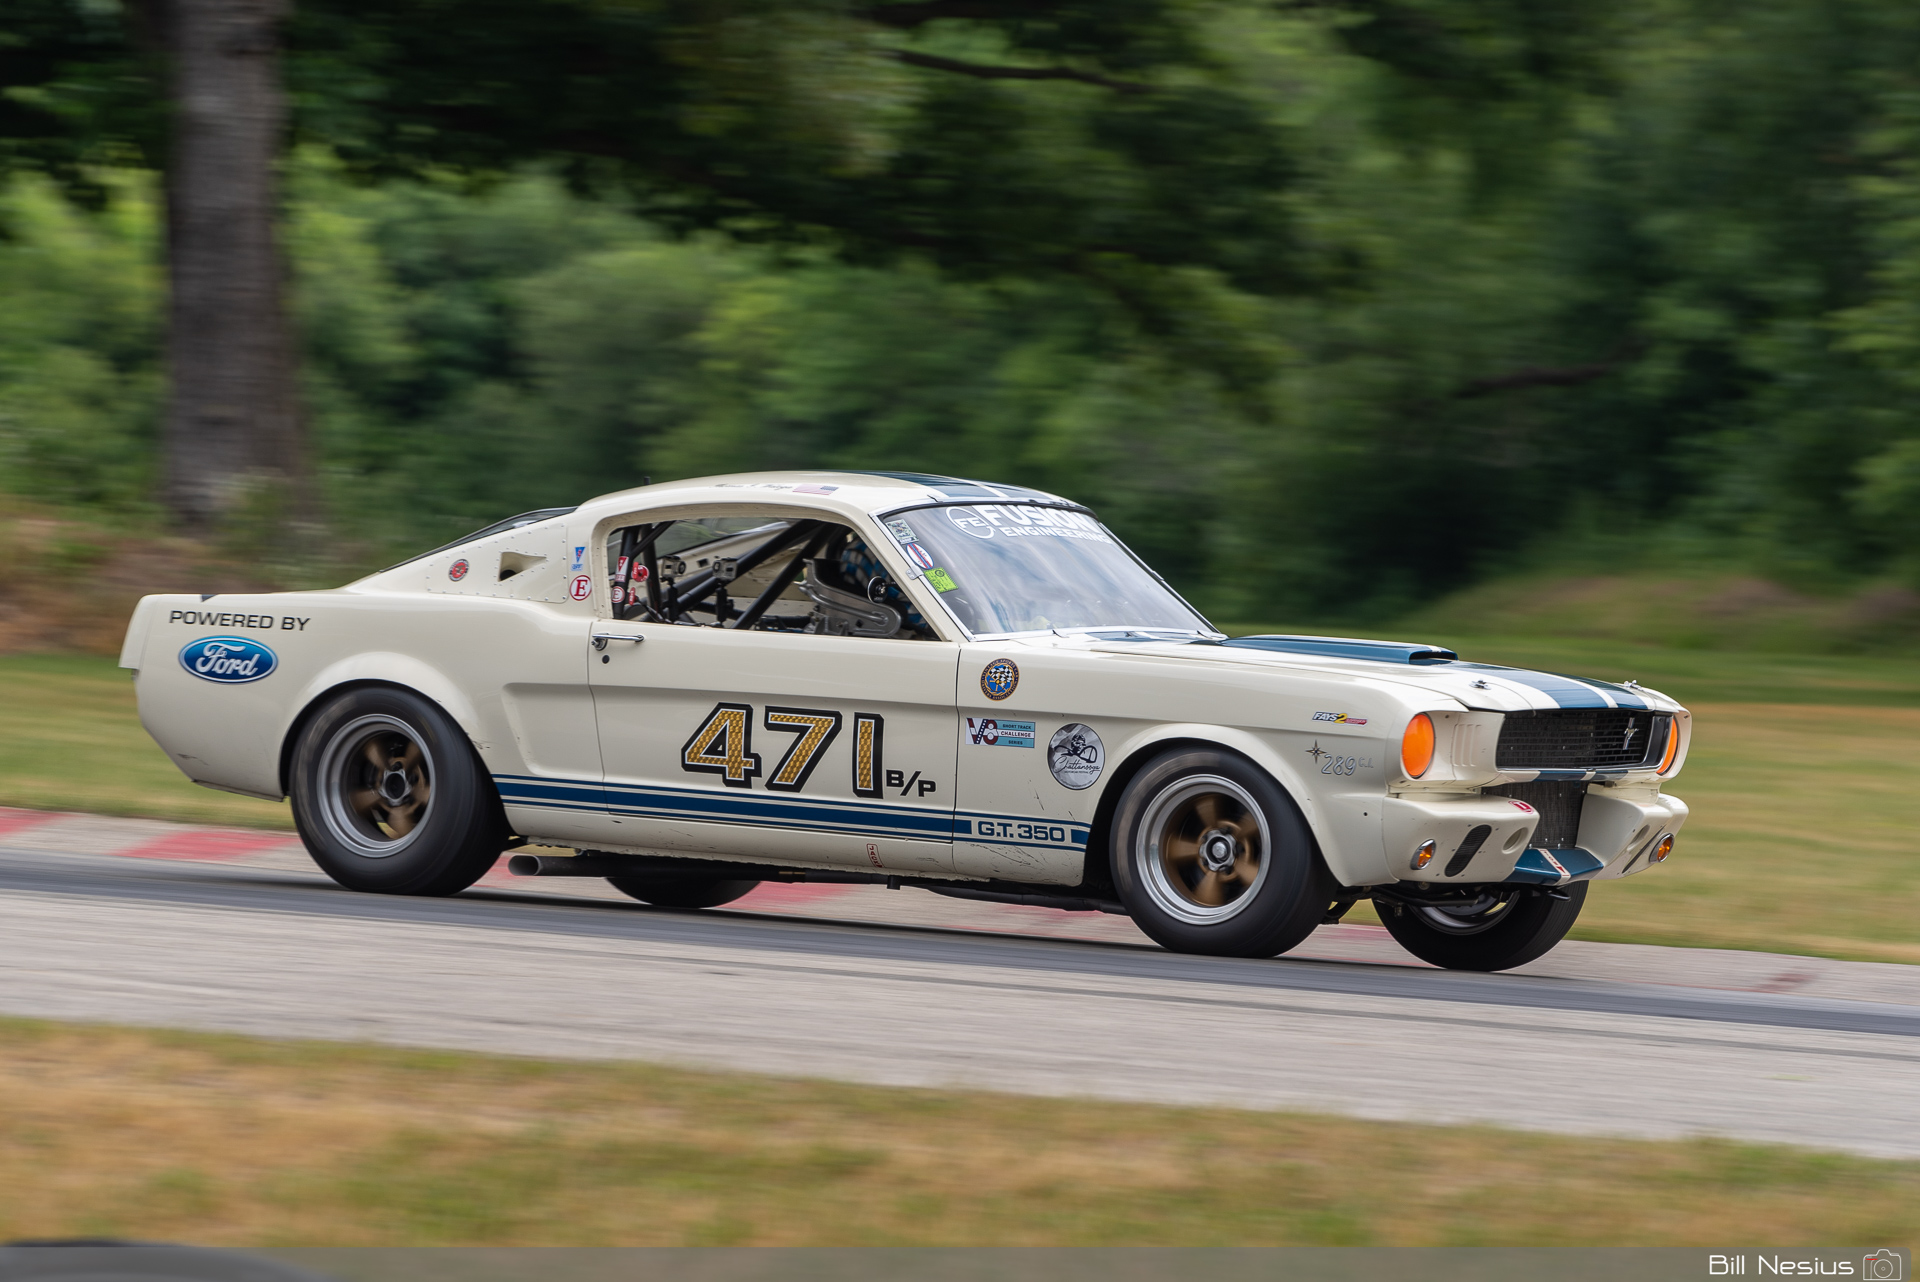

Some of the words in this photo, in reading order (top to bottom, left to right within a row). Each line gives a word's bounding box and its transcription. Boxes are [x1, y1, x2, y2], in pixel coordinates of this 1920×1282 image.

[953, 517, 989, 529] FE
[972, 505, 1103, 534] FUSION
[999, 526, 1114, 544] ENGINEERING
[574, 579, 588, 597] E
[168, 610, 275, 629] POWERED
[280, 616, 311, 631] BY
[195, 642, 261, 676] Ford
[966, 717, 999, 745] V8
[681, 702, 885, 799] 471
[1053, 756, 1101, 775] Chattanooga
[1321, 754, 1356, 776] 289
[886, 769, 937, 797] B/P
